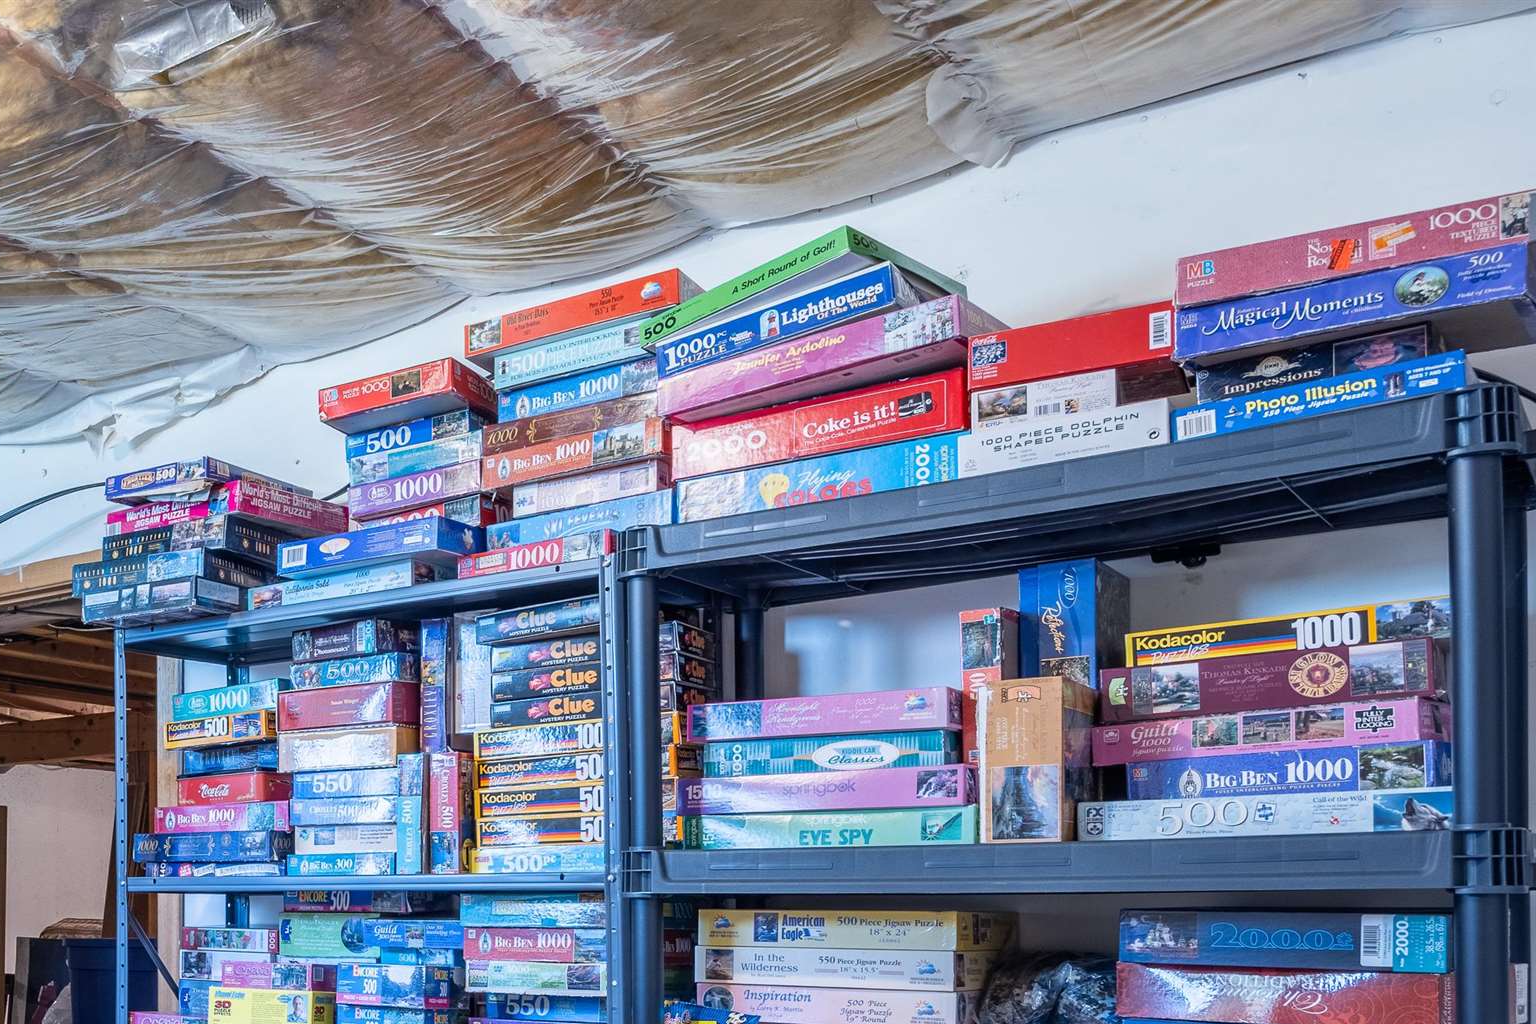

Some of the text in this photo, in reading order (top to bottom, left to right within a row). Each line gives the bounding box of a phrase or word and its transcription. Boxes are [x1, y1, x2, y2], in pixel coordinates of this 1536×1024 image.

[1429, 204, 1497, 230] 1000
[731, 239, 836, 295] A Short Round of Golf!
[1468, 251, 1504, 267] 500
[1187, 260, 1215, 279] MB
[781, 280, 884, 326] Lighthouses
[850, 295, 877, 313] World
[1202, 290, 1384, 336] Magical Moments
[644, 316, 677, 339] 500
[663, 333, 716, 370] 1000
[680, 344, 727, 366] PUZZLE
[732, 334, 846, 375] Jennifer Ardolino
[1224, 368, 1323, 395] Impressions
[532, 374, 619, 410] BIG BEN 1000
[1244, 378, 1377, 415] Photo Illusion
[803, 401, 896, 440] Coke is it!
[981, 412, 1139, 447] 1000 PIECE DOLPHIN
[366, 426, 411, 453] 500
[993, 423, 1125, 453] SHAPED PUZZLE
[514, 439, 590, 472] BIG BEN 1000
[394, 473, 442, 501] 1000
[510, 543, 559, 570] 1000
[516, 610, 557, 628] Clue
[1136, 630, 1225, 651] Kodacolor
[1291, 612, 1362, 650] 1000
[550, 639, 598, 657] Clue
[551, 667, 598, 686] Clue
[568, 684, 589, 692] PUZZLE
[209, 690, 248, 712] 1000
[548, 696, 595, 716] Clue
[1362, 709, 1385, 717] FULLY
[204, 717, 228, 737] 500
[1130, 720, 1177, 741] Guild
[1357, 721, 1394, 729] LOCKING
[480, 761, 533, 775] Kodacolor
[828, 754, 886, 766] Classics
[1206, 757, 1353, 788] BIG BEN 1000
[313, 774, 352, 793] 550
[783, 779, 856, 797] springbok
[482, 790, 537, 803] Kodacolor
[209, 808, 234, 822] 1000
[1158, 800, 1249, 836] 500
[798, 828, 874, 846] EYE SPY
[330, 891, 350, 911] 500
[781, 915, 825, 928] American
[837, 916, 944, 929] 500 Piece Jigsaw Puzzle
[494, 932, 571, 949] BIG BEN 1000
[781, 927, 803, 941] Eagle
[1395, 920, 1409, 955] 2000
[754, 953, 784, 962] In the
[818, 956, 836, 964] 550
[856, 959, 877, 967] Jigsaw
[353, 965, 379, 978] ENCORE
[741, 963, 798, 972] Wilderness
[362, 978, 376, 994] 500
[214, 1000, 232, 1009] 3D
[505, 995, 550, 1017] 550
[744, 989, 812, 1007] Inspiration
[847, 999, 887, 1008] 500 Piece
[355, 1007, 380, 1021] ENCORE
[840, 1008, 892, 1018] Jigsaw Puzzle
[861, 1015, 886, 1024] Round
